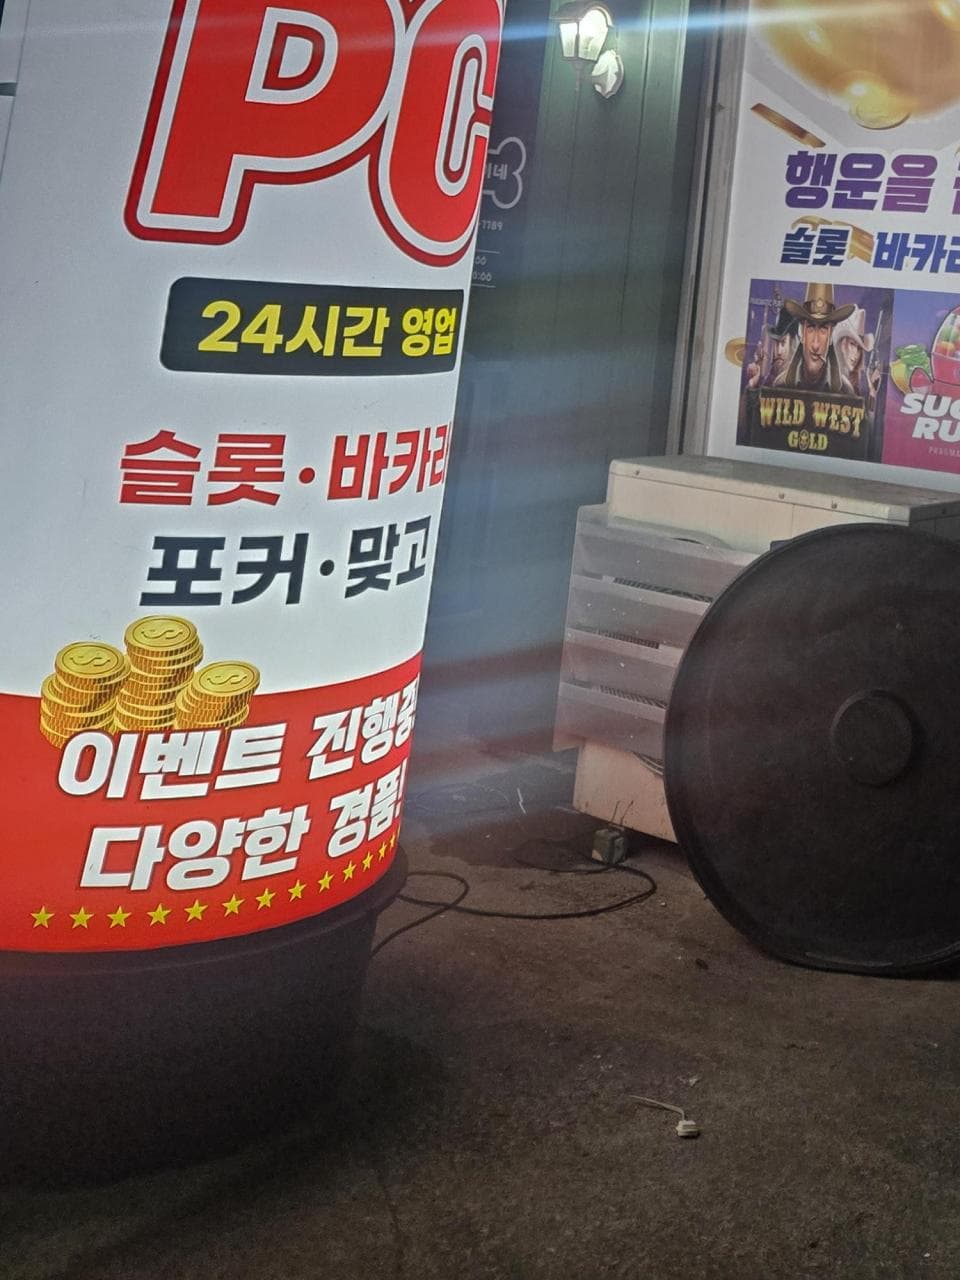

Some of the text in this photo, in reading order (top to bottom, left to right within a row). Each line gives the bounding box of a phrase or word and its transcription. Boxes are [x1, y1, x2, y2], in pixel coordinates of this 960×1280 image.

[785, 150, 938, 213] 행운을
[780, 226, 851, 267] 슬롯
[198, 300, 457, 357] 24시간 영업
[759, 397, 865, 438] WILD WEST
[787, 429, 829, 451] GOLD
[57, 722, 287, 801] 이벤트
[80, 757, 408, 891] 다양한 경품!
